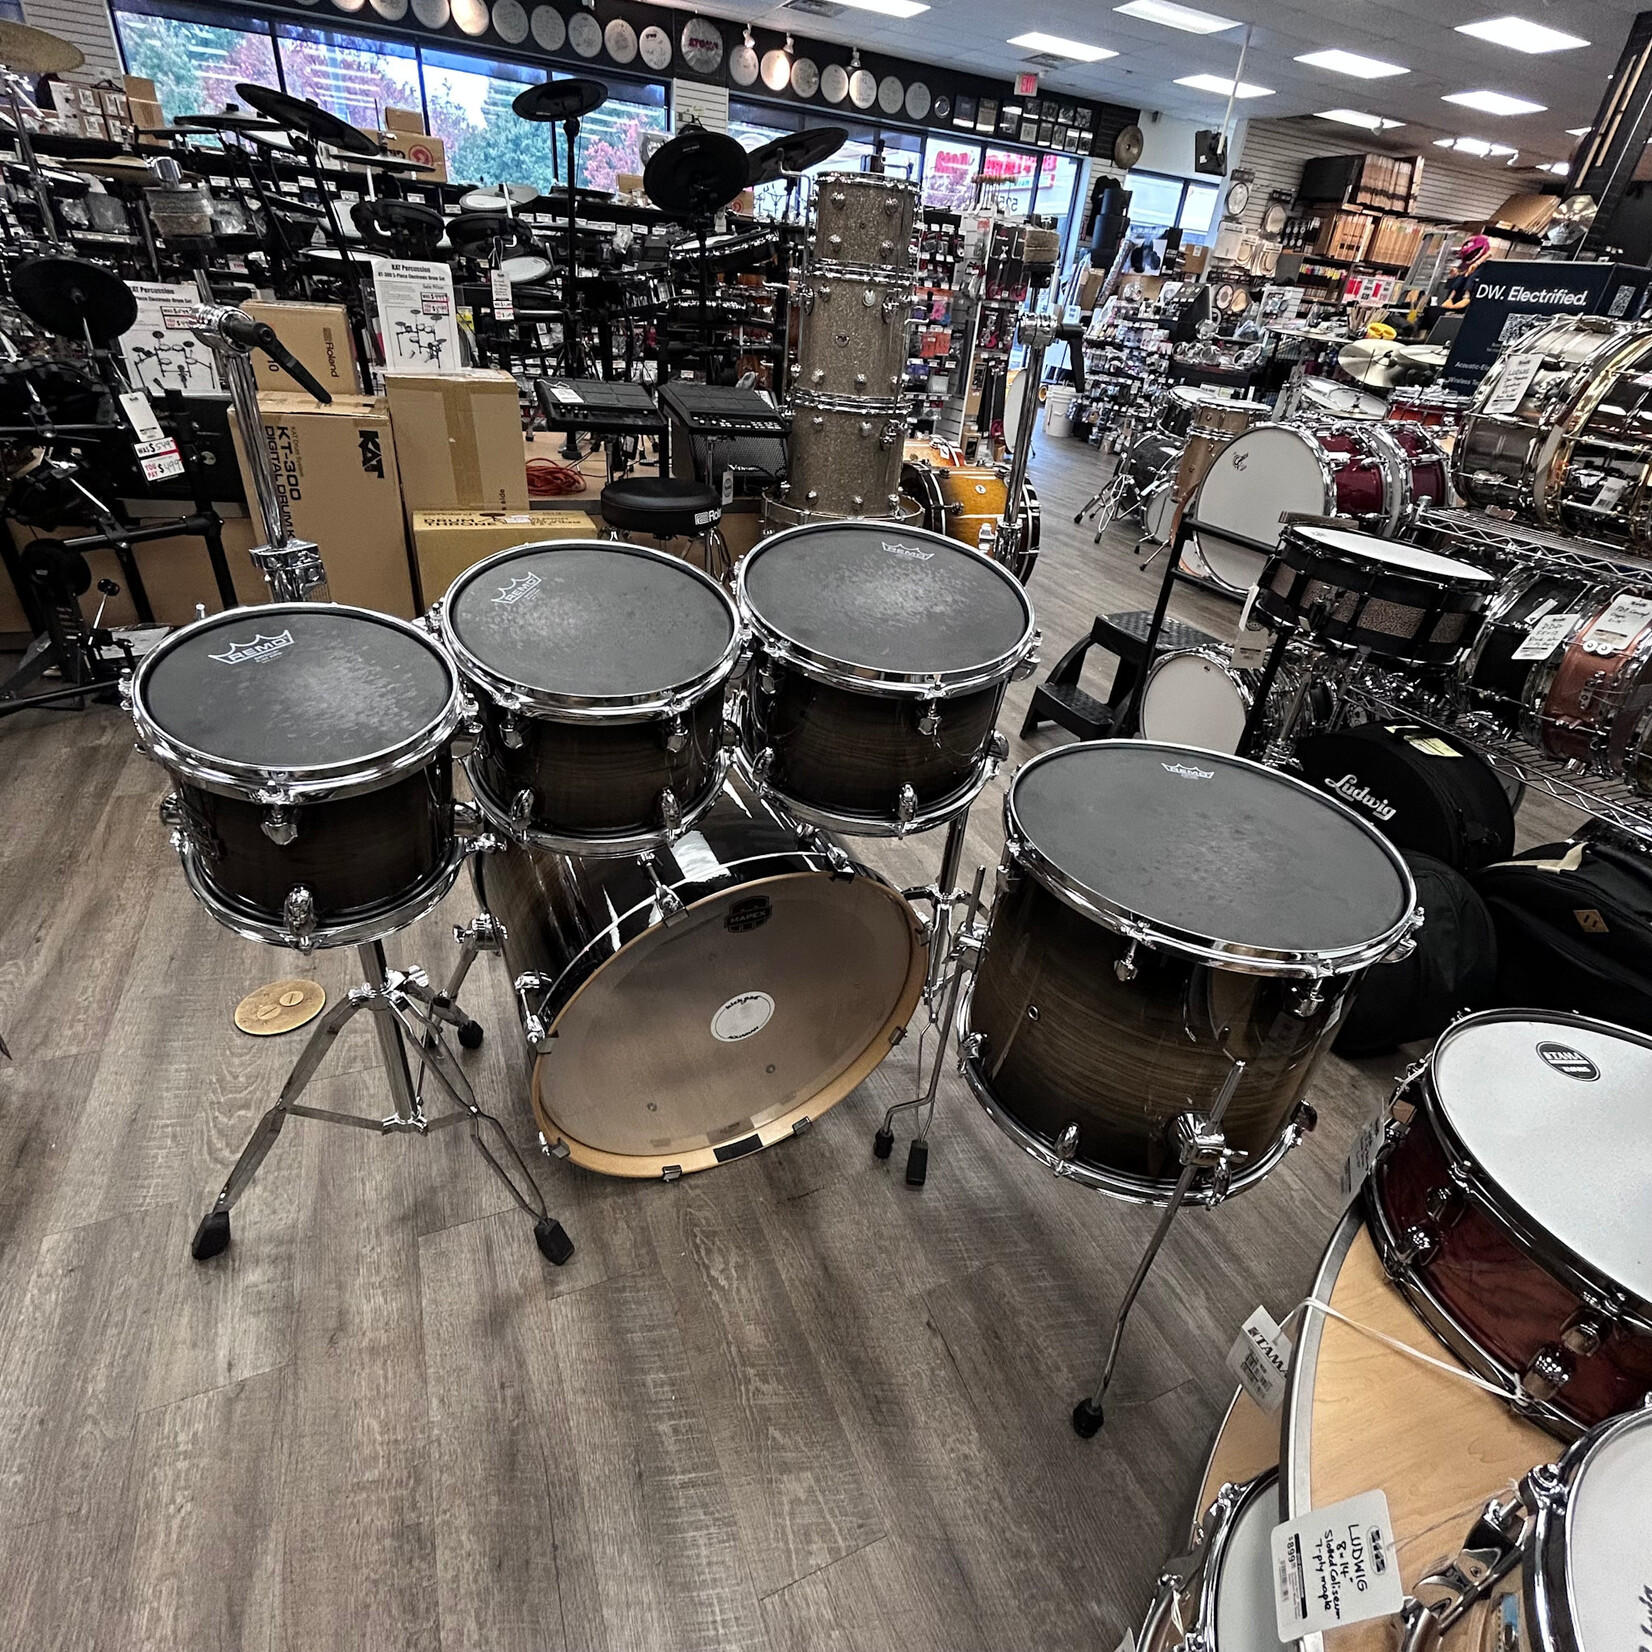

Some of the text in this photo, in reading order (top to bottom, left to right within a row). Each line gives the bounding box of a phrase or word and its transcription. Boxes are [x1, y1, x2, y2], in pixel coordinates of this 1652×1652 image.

[1475, 284, 1587, 306] DW. Electrified.
[324, 341, 339, 378] Roland
[137, 446, 150, 454] WAS
[144, 463, 157, 471] YOU
[276, 425, 302, 501] KT-300
[358, 429, 385, 479] KAT
[264, 425, 284, 482] DIGITAL
[277, 484, 294, 526] DRUM
[505, 578, 537, 601] REMO
[228, 638, 287, 661] REMO
[1324, 774, 1397, 821] Ludwig
[730, 910, 767, 924] MAPEX
[1324, 1529, 1341, 1620] Slotted Coliseum
[1348, 1523, 1369, 1592] LUDWIG
[1318, 1575, 1332, 1611] maple
